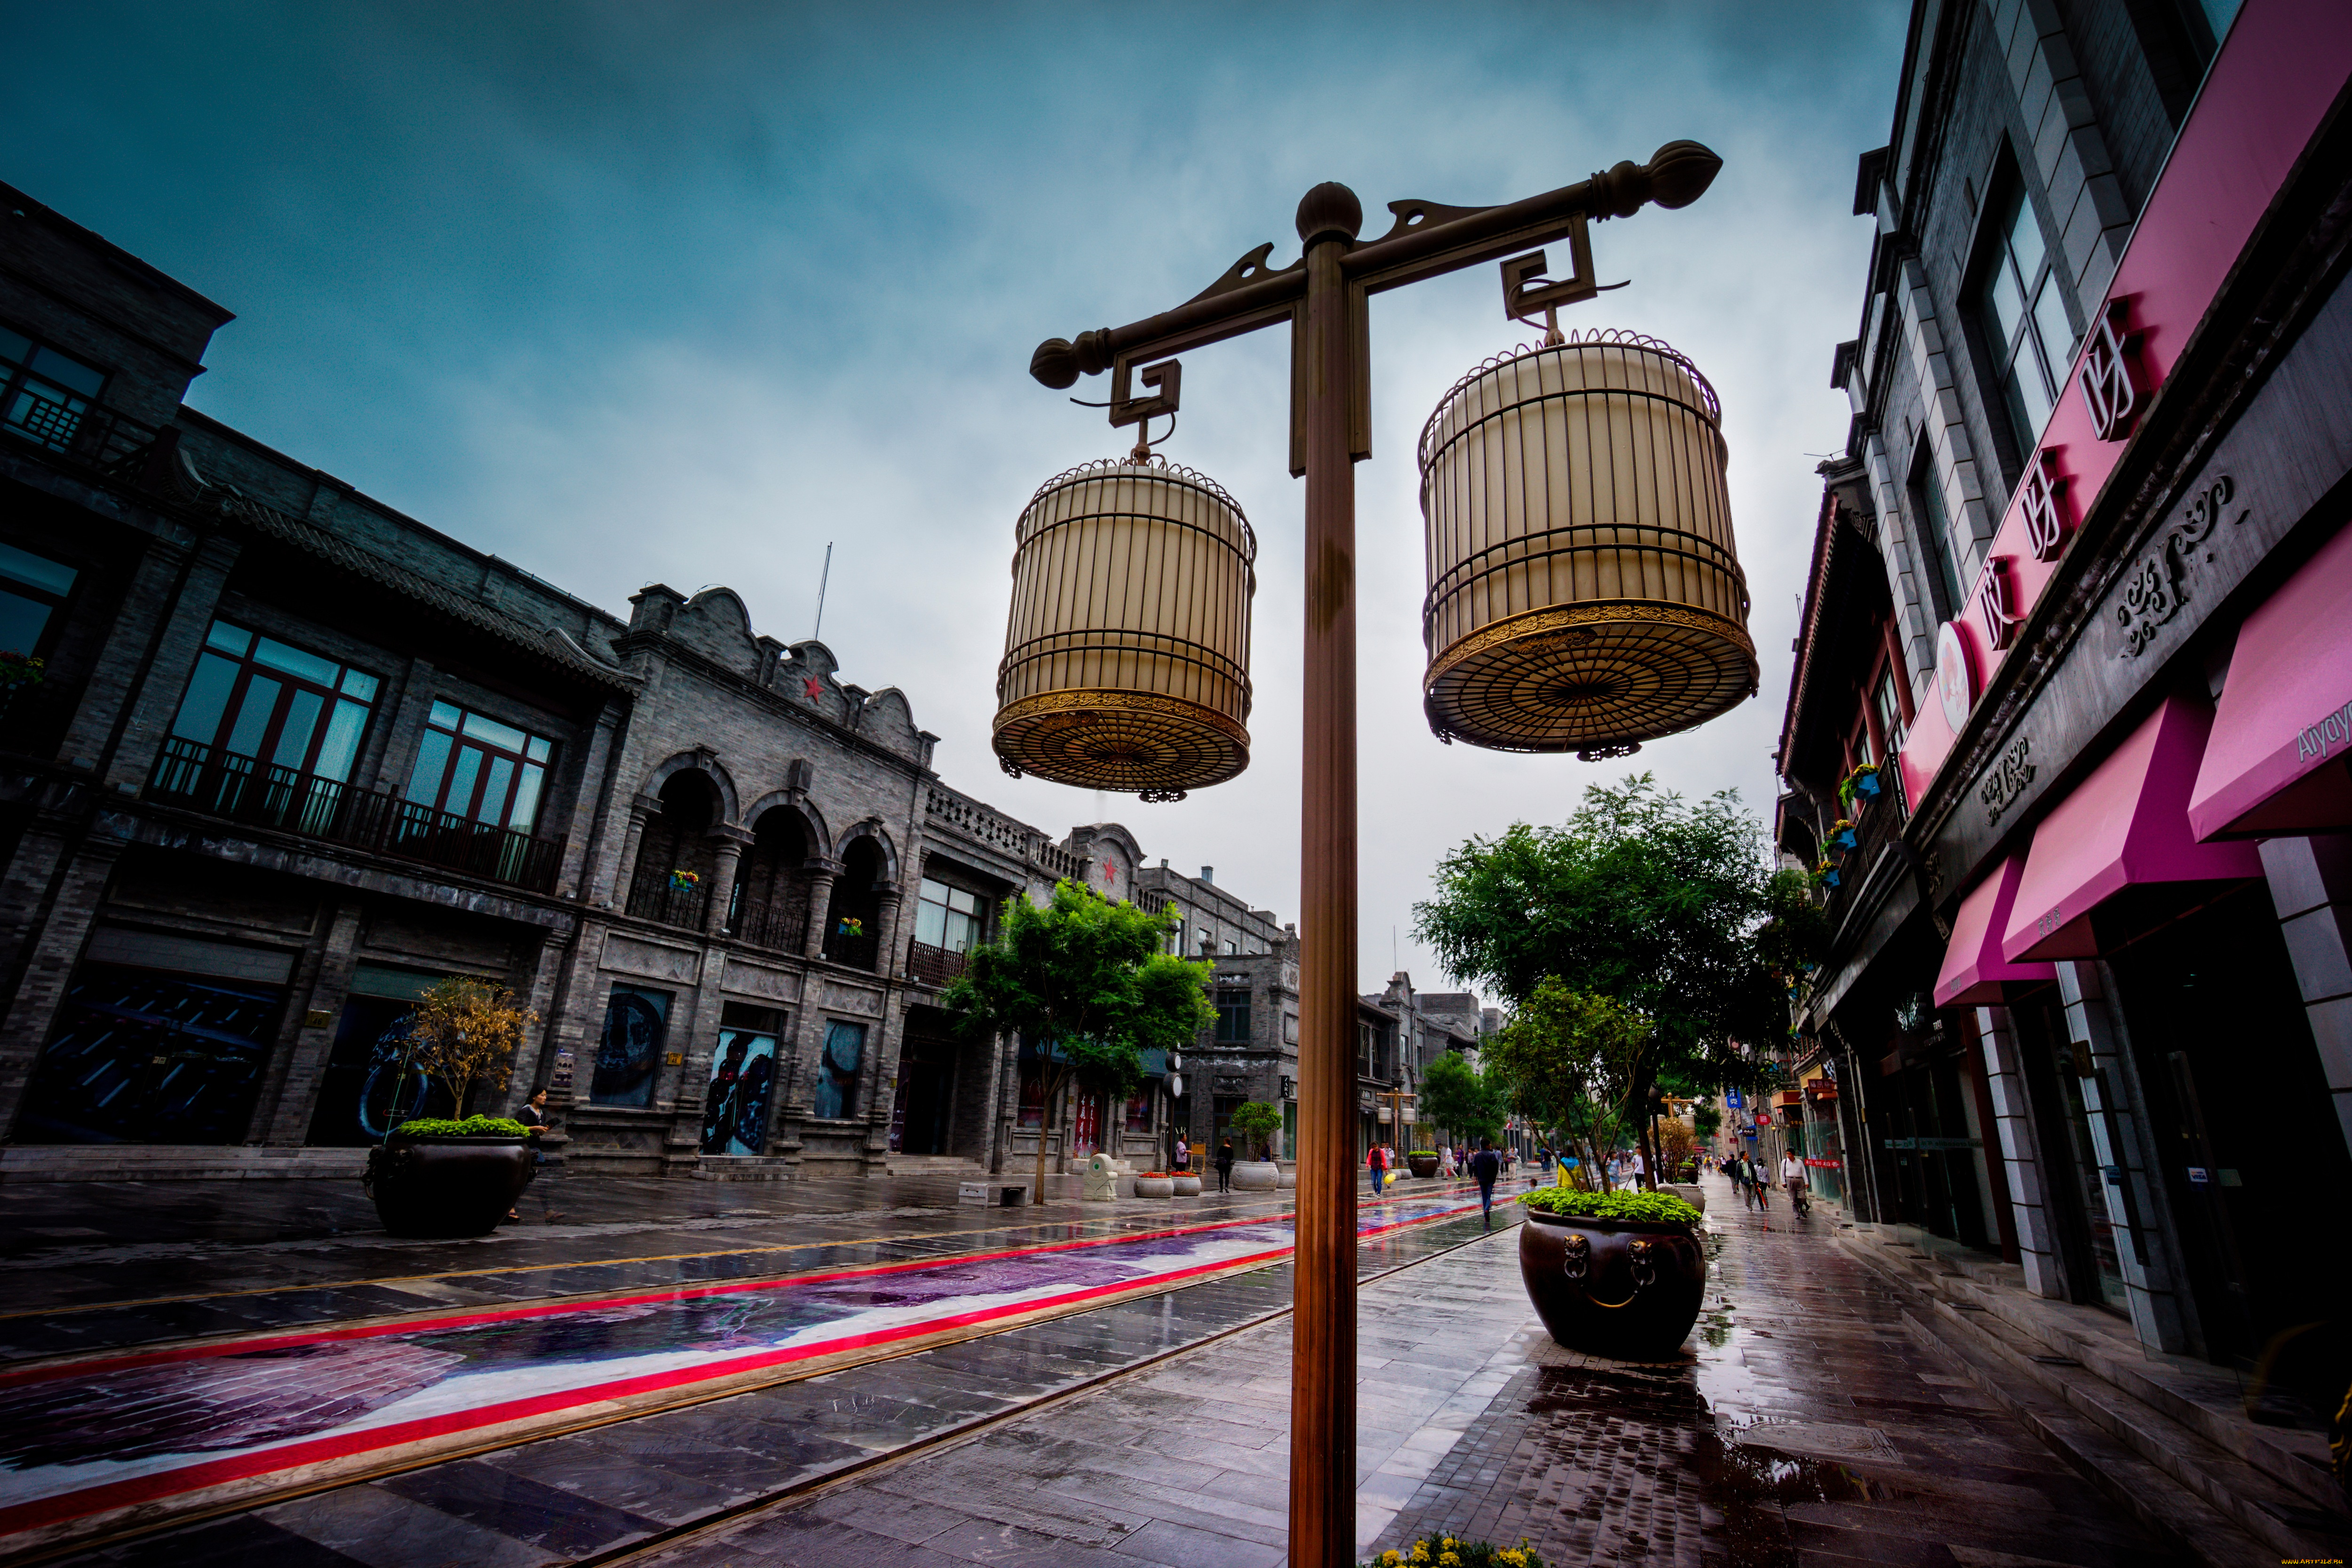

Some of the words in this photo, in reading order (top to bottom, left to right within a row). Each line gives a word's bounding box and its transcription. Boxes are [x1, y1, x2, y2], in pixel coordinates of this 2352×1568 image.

[1978, 300, 2134, 652] 哎呀呀
[2038, 907, 2061, 938] 哎呀呀
